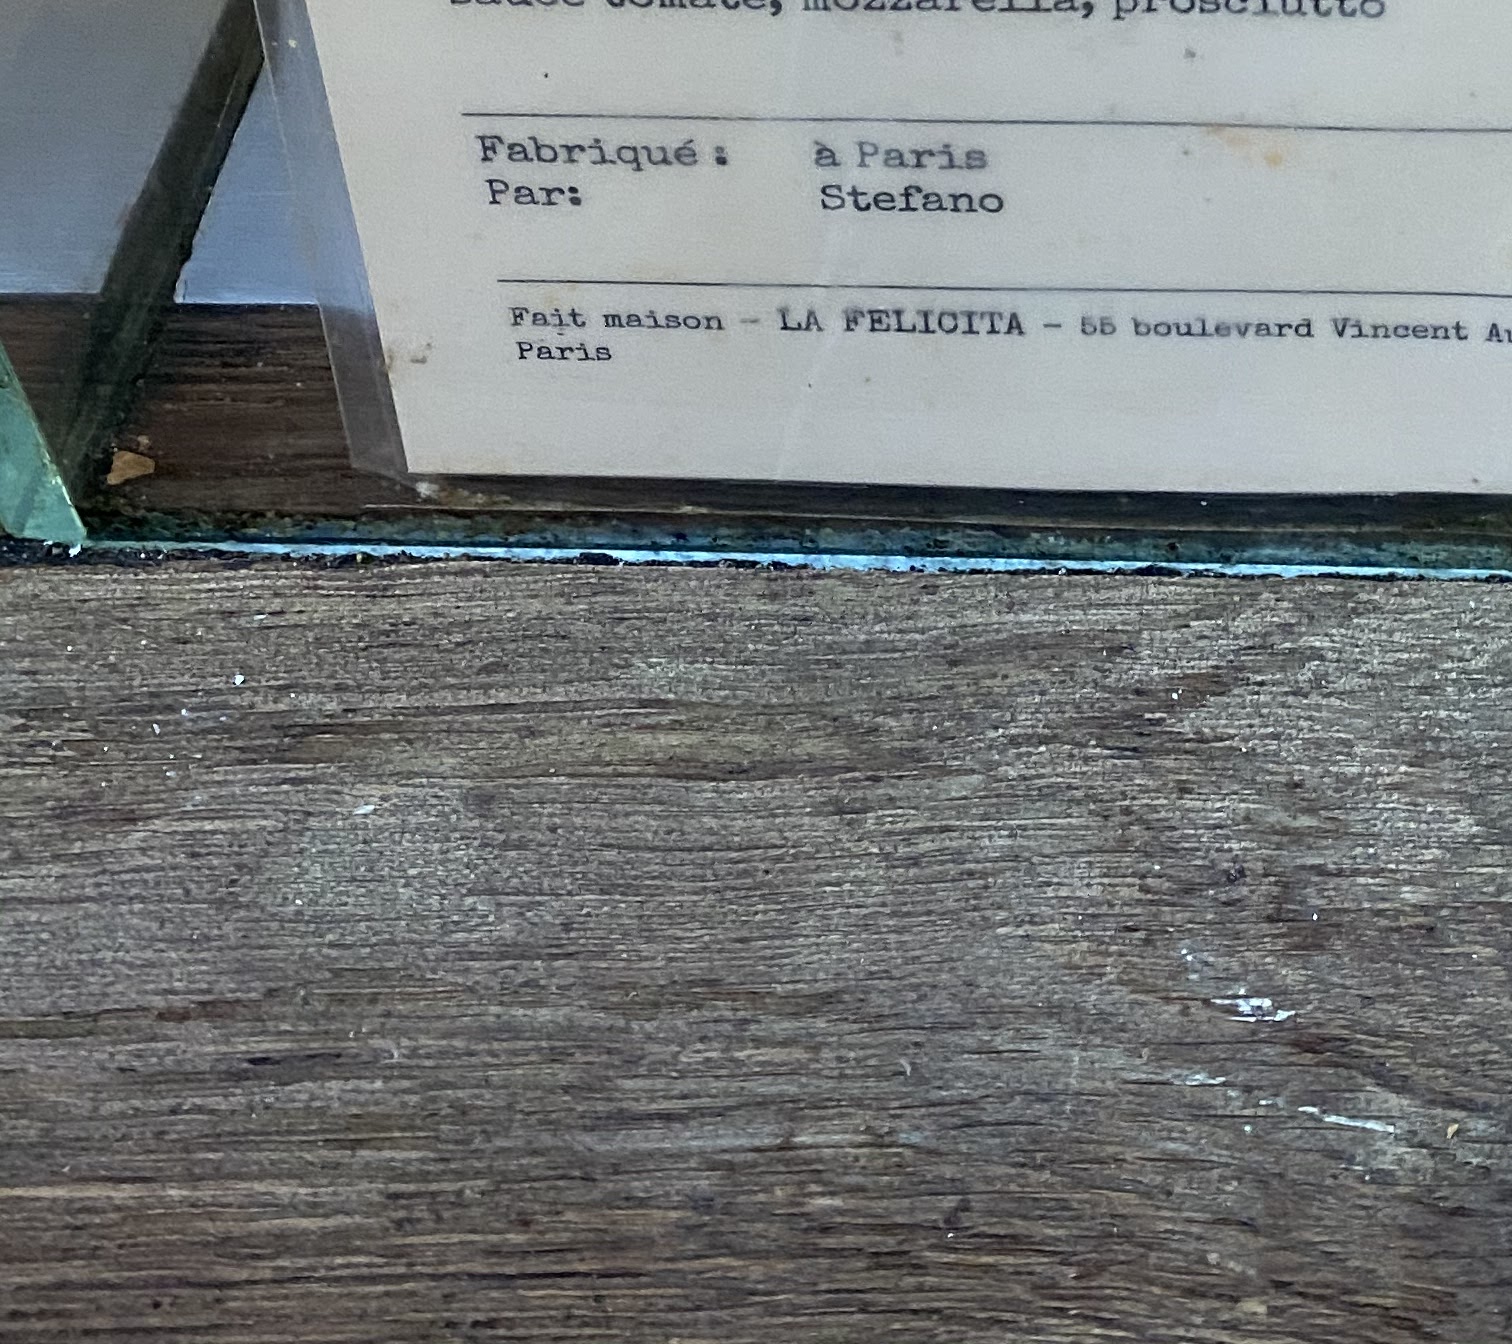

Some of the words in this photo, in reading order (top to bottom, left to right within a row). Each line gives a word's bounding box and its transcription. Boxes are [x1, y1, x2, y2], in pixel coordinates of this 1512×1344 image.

[812, 139, 843, 168] à
[855, 140, 990, 172] Paris
[483, 178, 583, 207] Par:
[819, 183, 1006, 214] Stefano
[507, 306, 587, 330] Fait
[601, 309, 726, 332] maison
[775, 305, 825, 333] LA
[841, 305, 1028, 338] FELICITA
[1080, 315, 1118, 337] 55
[1130, 316, 1315, 339] boulevard
[1329, 316, 1469, 342] Vincent
[514, 340, 613, 362] Paris
